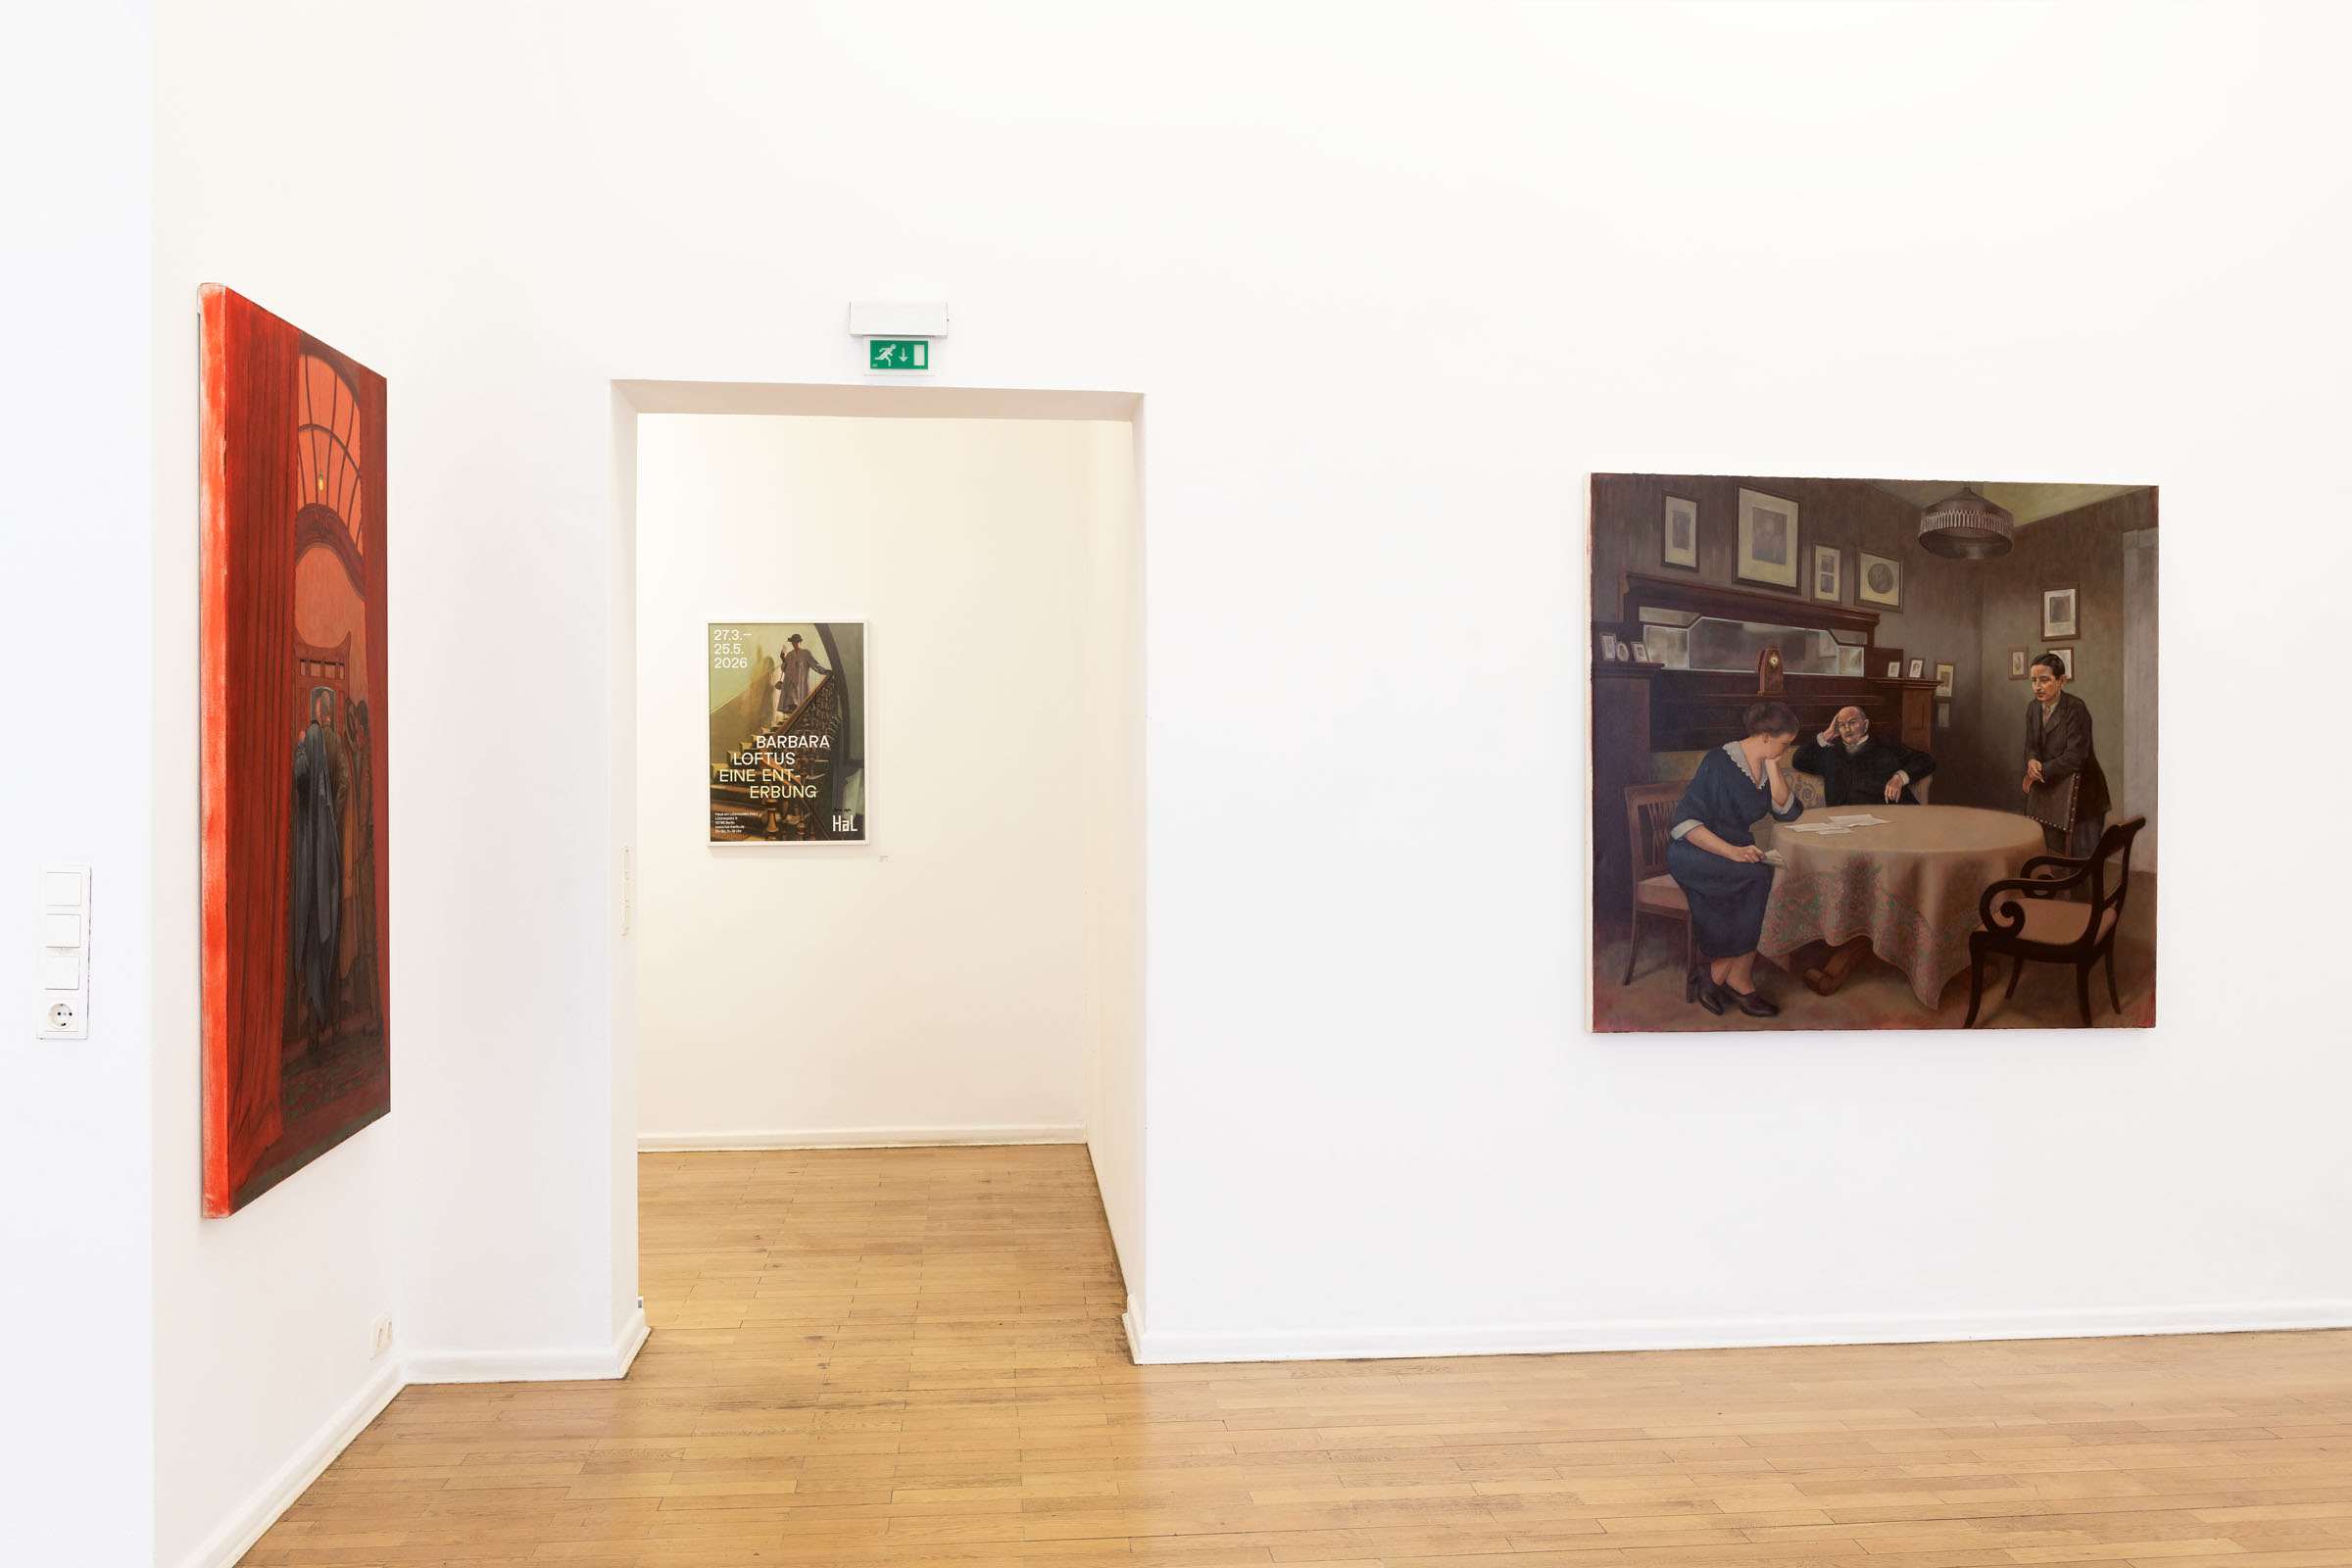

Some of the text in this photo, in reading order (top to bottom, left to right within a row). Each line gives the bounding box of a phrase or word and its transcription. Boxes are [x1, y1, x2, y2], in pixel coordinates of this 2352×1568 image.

[713, 643, 744, 655] 25.5.
[713, 657, 748, 668] 2026
[756, 735, 830, 749] BARBARA
[733, 752, 796, 765] LOFTUS
[719, 768, 801, 782] EINE ENT-
[750, 785, 817, 799] ERBUNG
[832, 814, 858, 832] HaL
